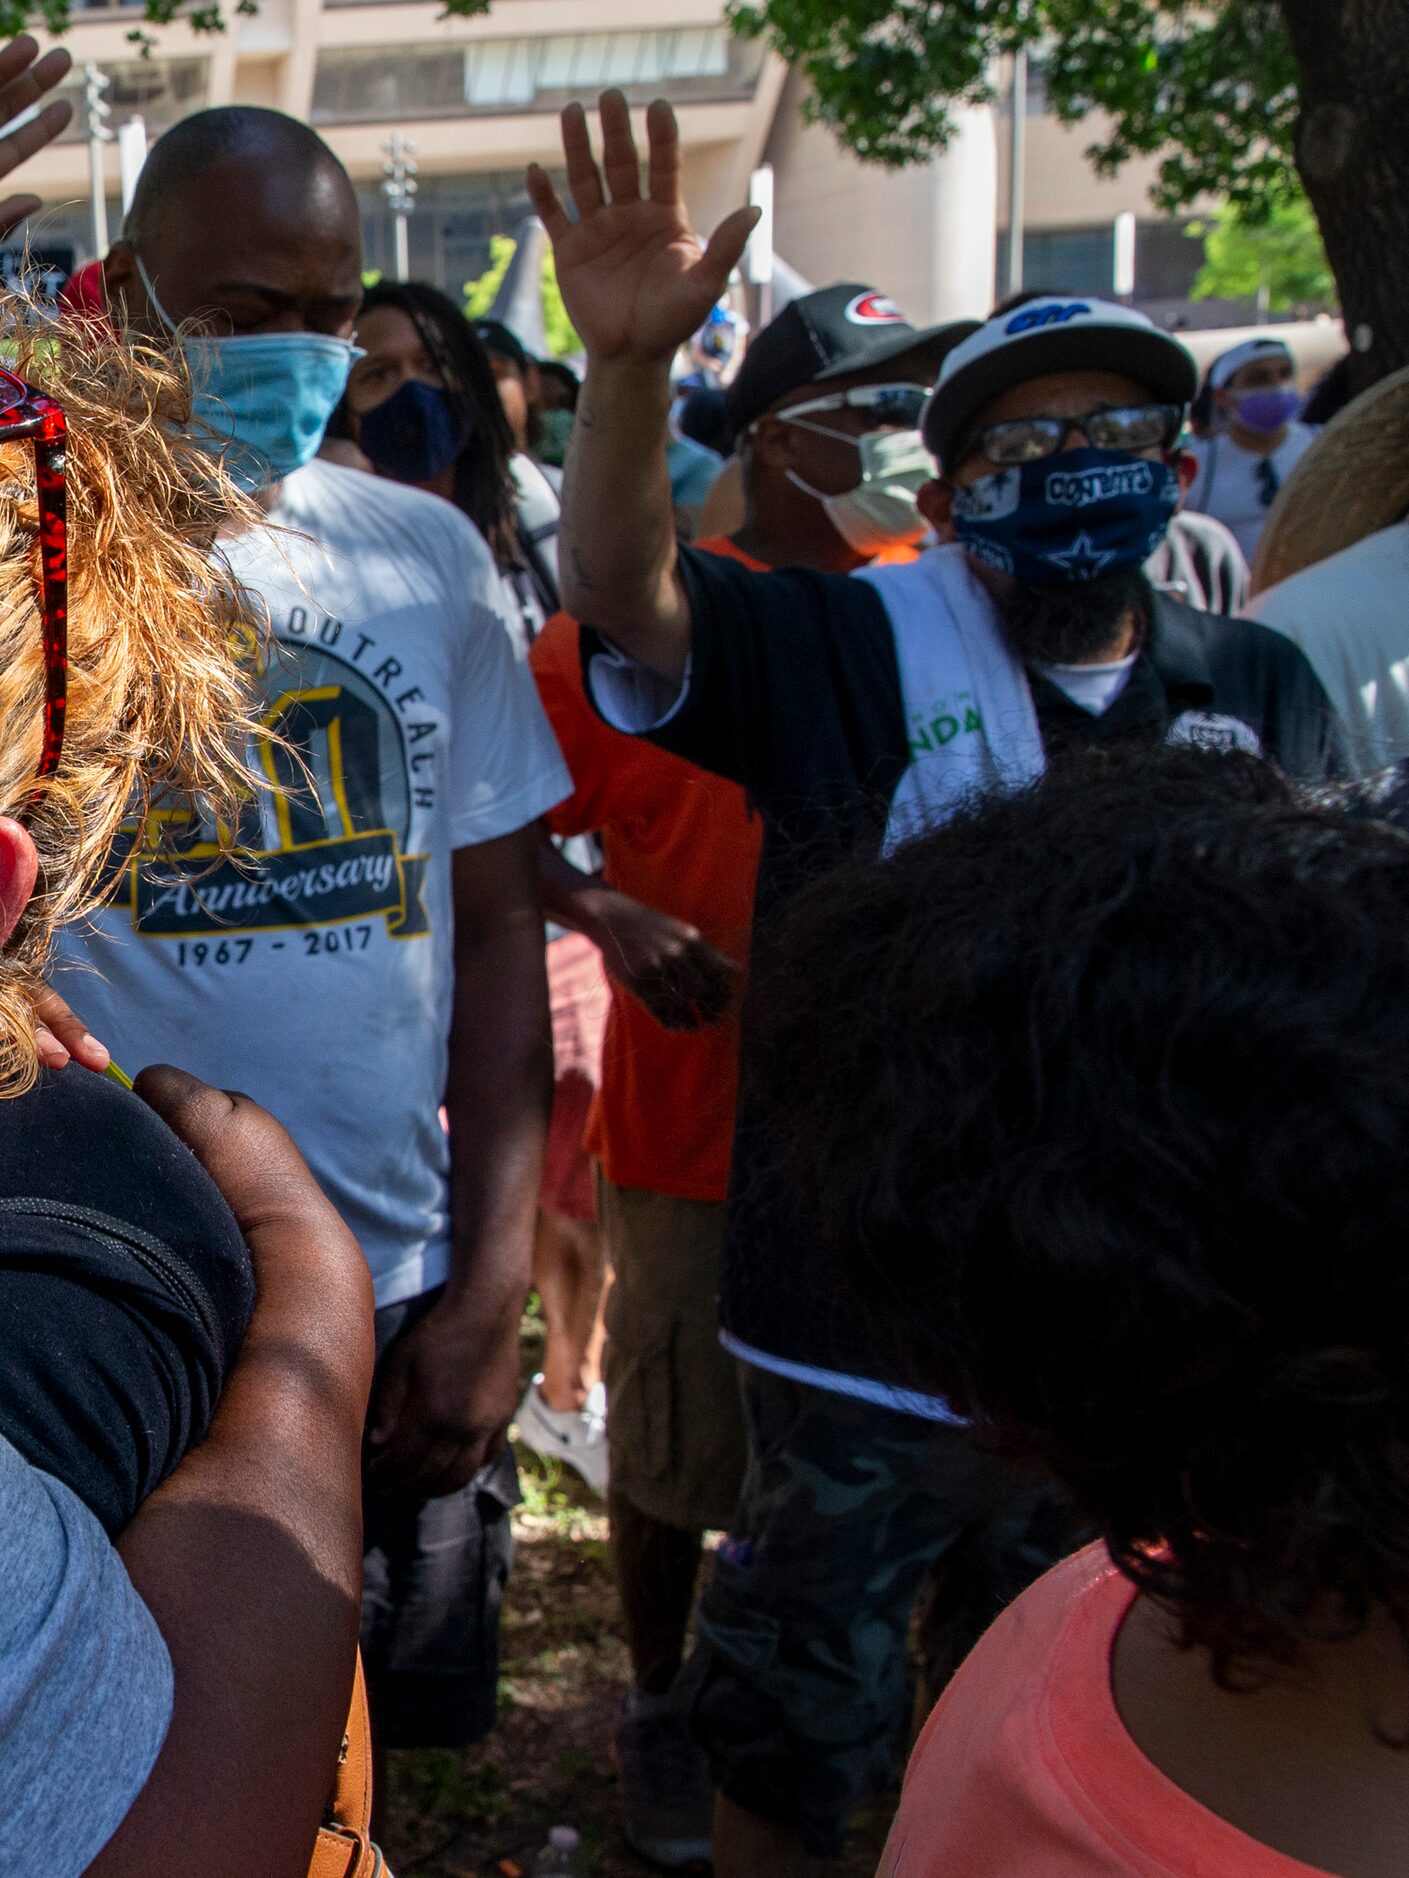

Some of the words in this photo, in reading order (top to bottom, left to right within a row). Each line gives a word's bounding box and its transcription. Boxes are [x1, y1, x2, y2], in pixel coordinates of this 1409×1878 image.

[146, 854, 393, 916] Anniversary
[178, 938, 253, 967] 1967
[304, 925, 372, 955] 2017
